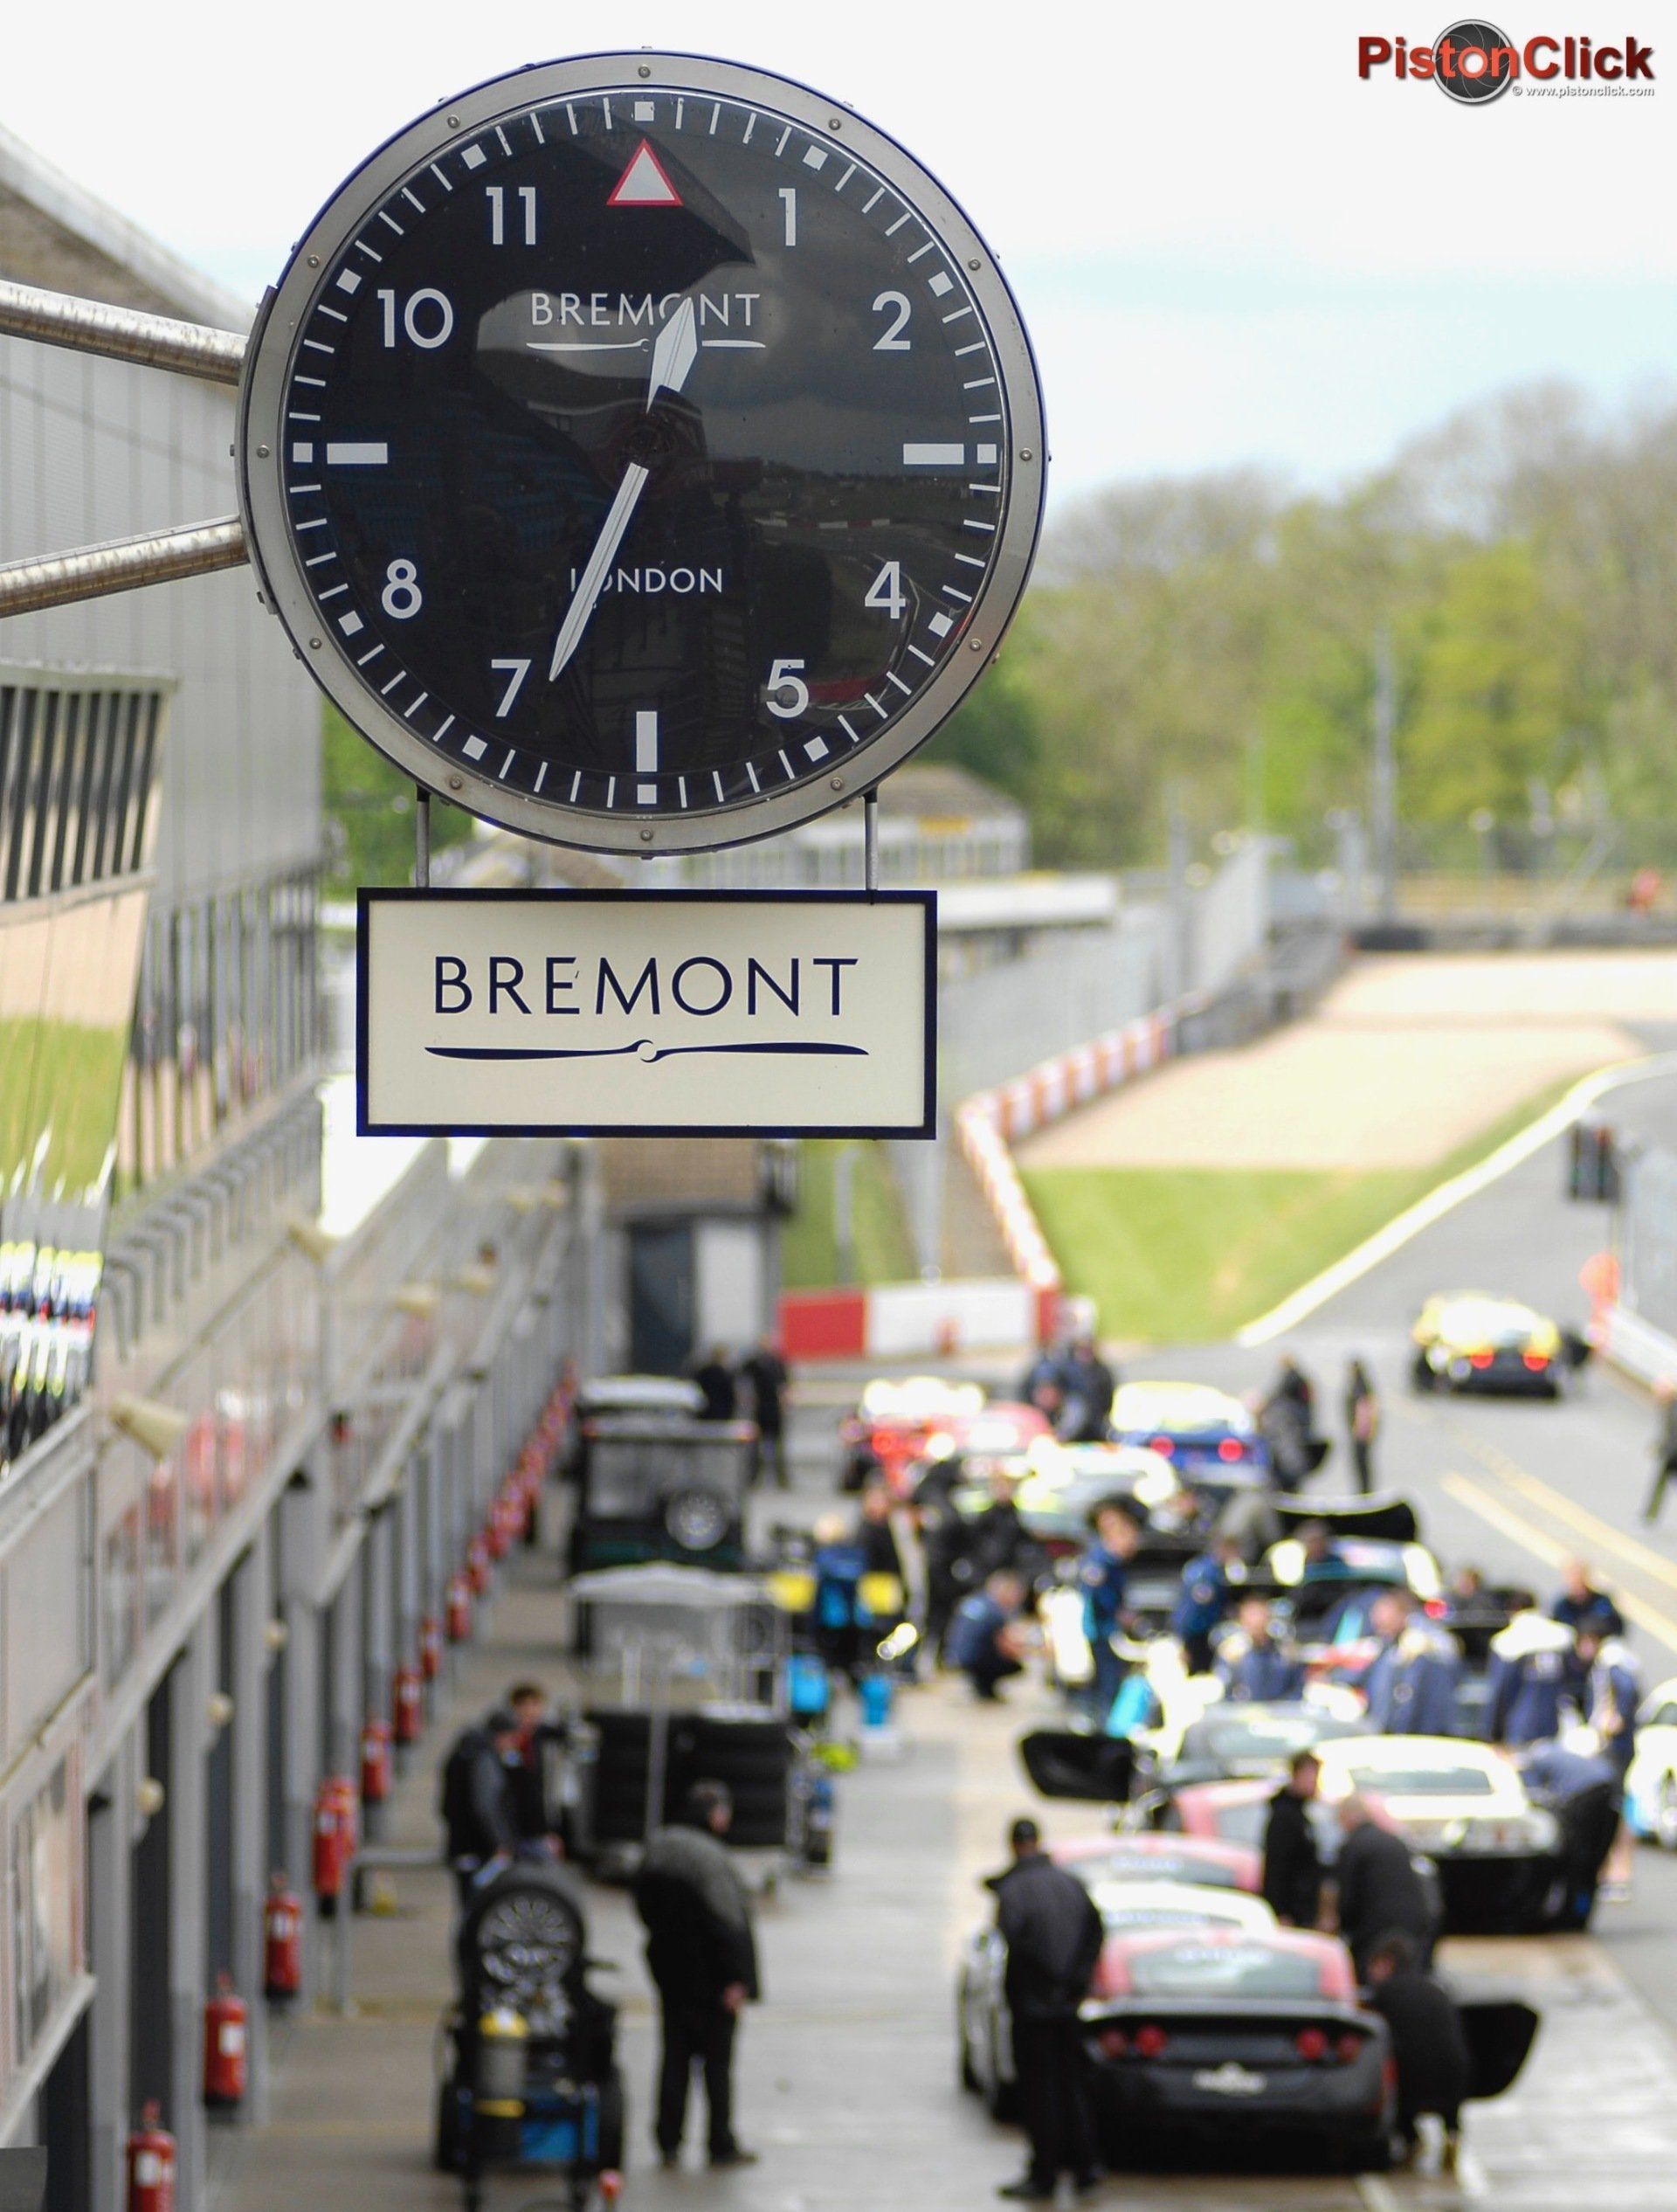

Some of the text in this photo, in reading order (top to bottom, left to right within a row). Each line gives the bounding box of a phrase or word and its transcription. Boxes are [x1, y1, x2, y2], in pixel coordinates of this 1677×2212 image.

[486, 186, 536, 245] 11
[778, 188, 797, 246] 1
[377, 288, 453, 349] 10
[872, 290, 912, 350] 2
[382, 558, 422, 619] 8
[570, 568, 722, 593] LNDON
[864, 561, 907, 619] 4
[491, 659, 531, 717] 7
[766, 659, 809, 718] 5
[435, 956, 859, 1016] BREMONT
